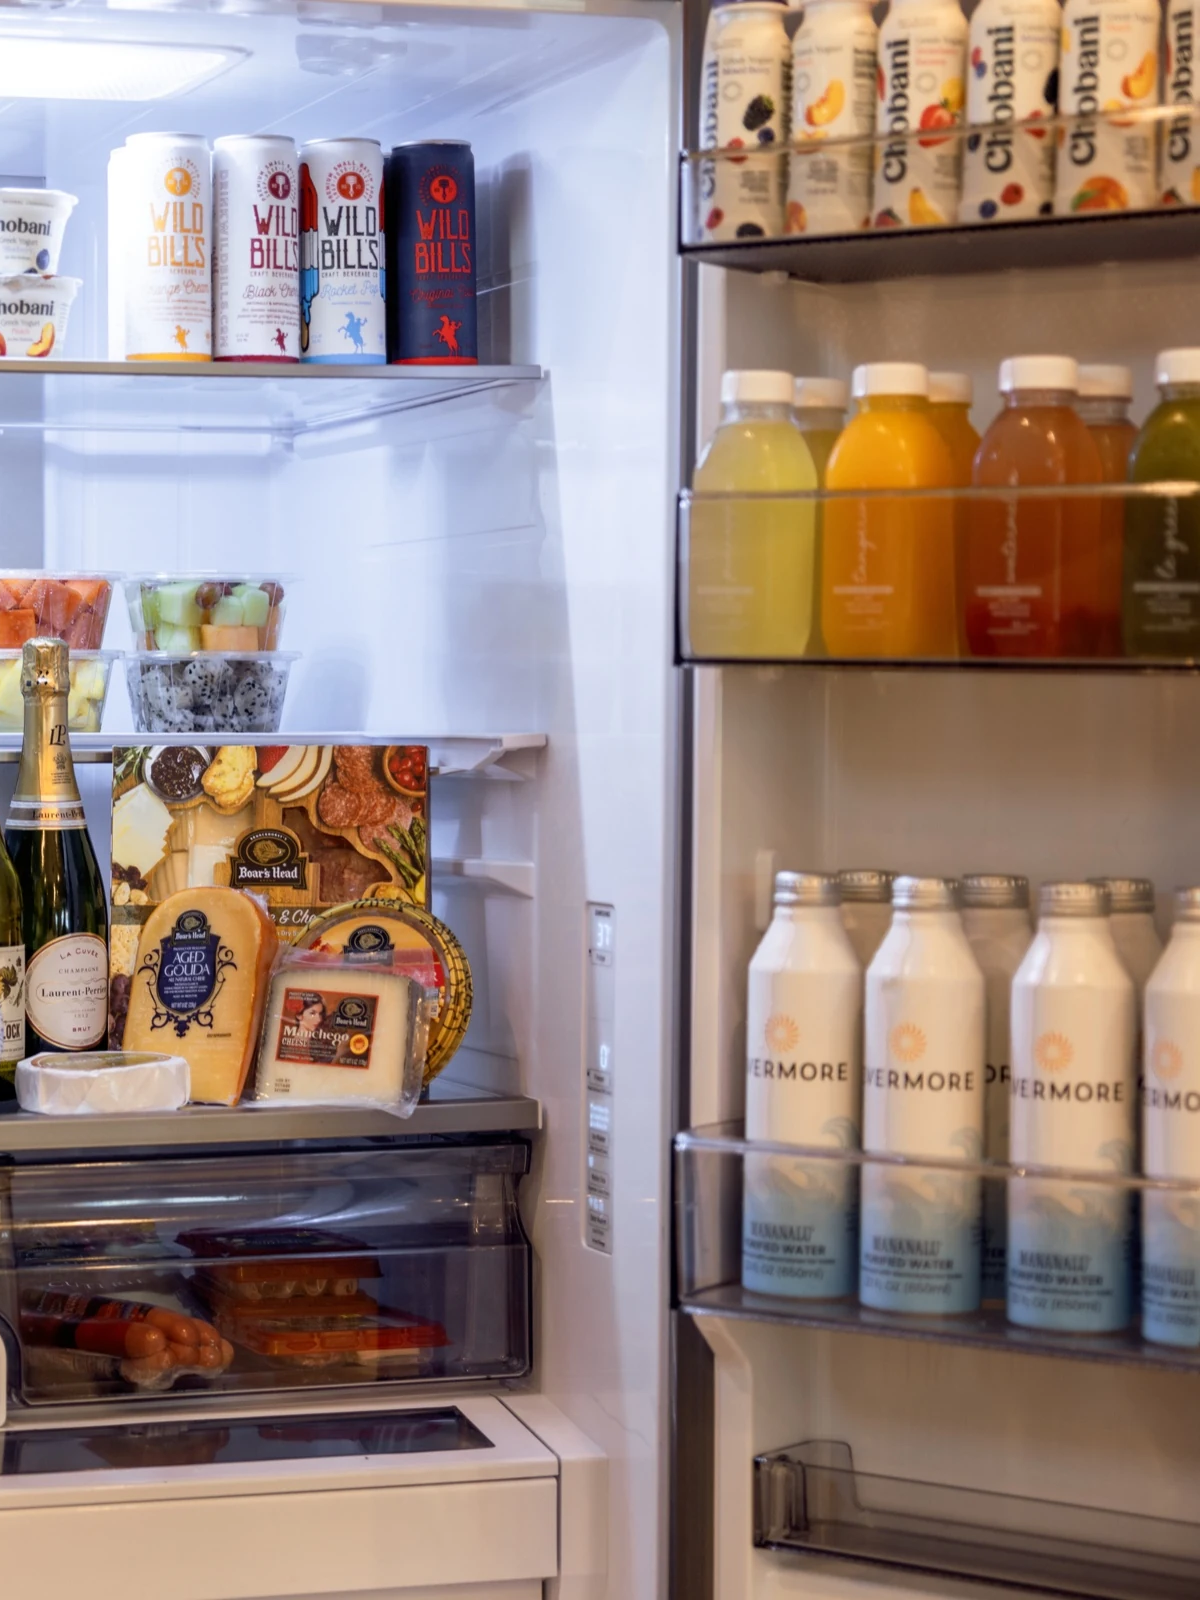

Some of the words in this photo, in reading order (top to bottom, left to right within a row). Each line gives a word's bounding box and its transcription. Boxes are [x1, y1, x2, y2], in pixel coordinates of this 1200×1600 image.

[985, 25, 1015, 173] Chobani
[1070, 16, 1099, 166] Chobani
[883, 38, 910, 183] Chobani
[150, 202, 204, 234] WILD
[252, 204, 298, 236] WILD
[322, 206, 377, 237] WILD
[415, 209, 469, 240] WILD
[147, 235, 206, 269] BILL'S
[250, 238, 298, 271] BILL'S
[321, 239, 379, 270] BILL'S
[414, 242, 472, 274] BILL'S
[242, 283, 277, 299] Black
[320, 283, 357, 300] Rocket
[238, 866, 270, 879] Boar's
[272, 866, 298, 879] Head
[279, 909, 290, 924] &
[597, 922, 612, 947] 37
[173, 950, 205, 964] AGED
[58, 966, 100, 975] CHAMPAGNE
[164, 963, 211, 977] GOUDA
[3, 1024, 21, 1040] OCK
[281, 1037, 308, 1048] CHEESE
[283, 1025, 350, 1047] Manchego
[781, 1244, 827, 1256] WATER
[908, 1259, 955, 1270] WATER
[1056, 1275, 1104, 1287] WATER
